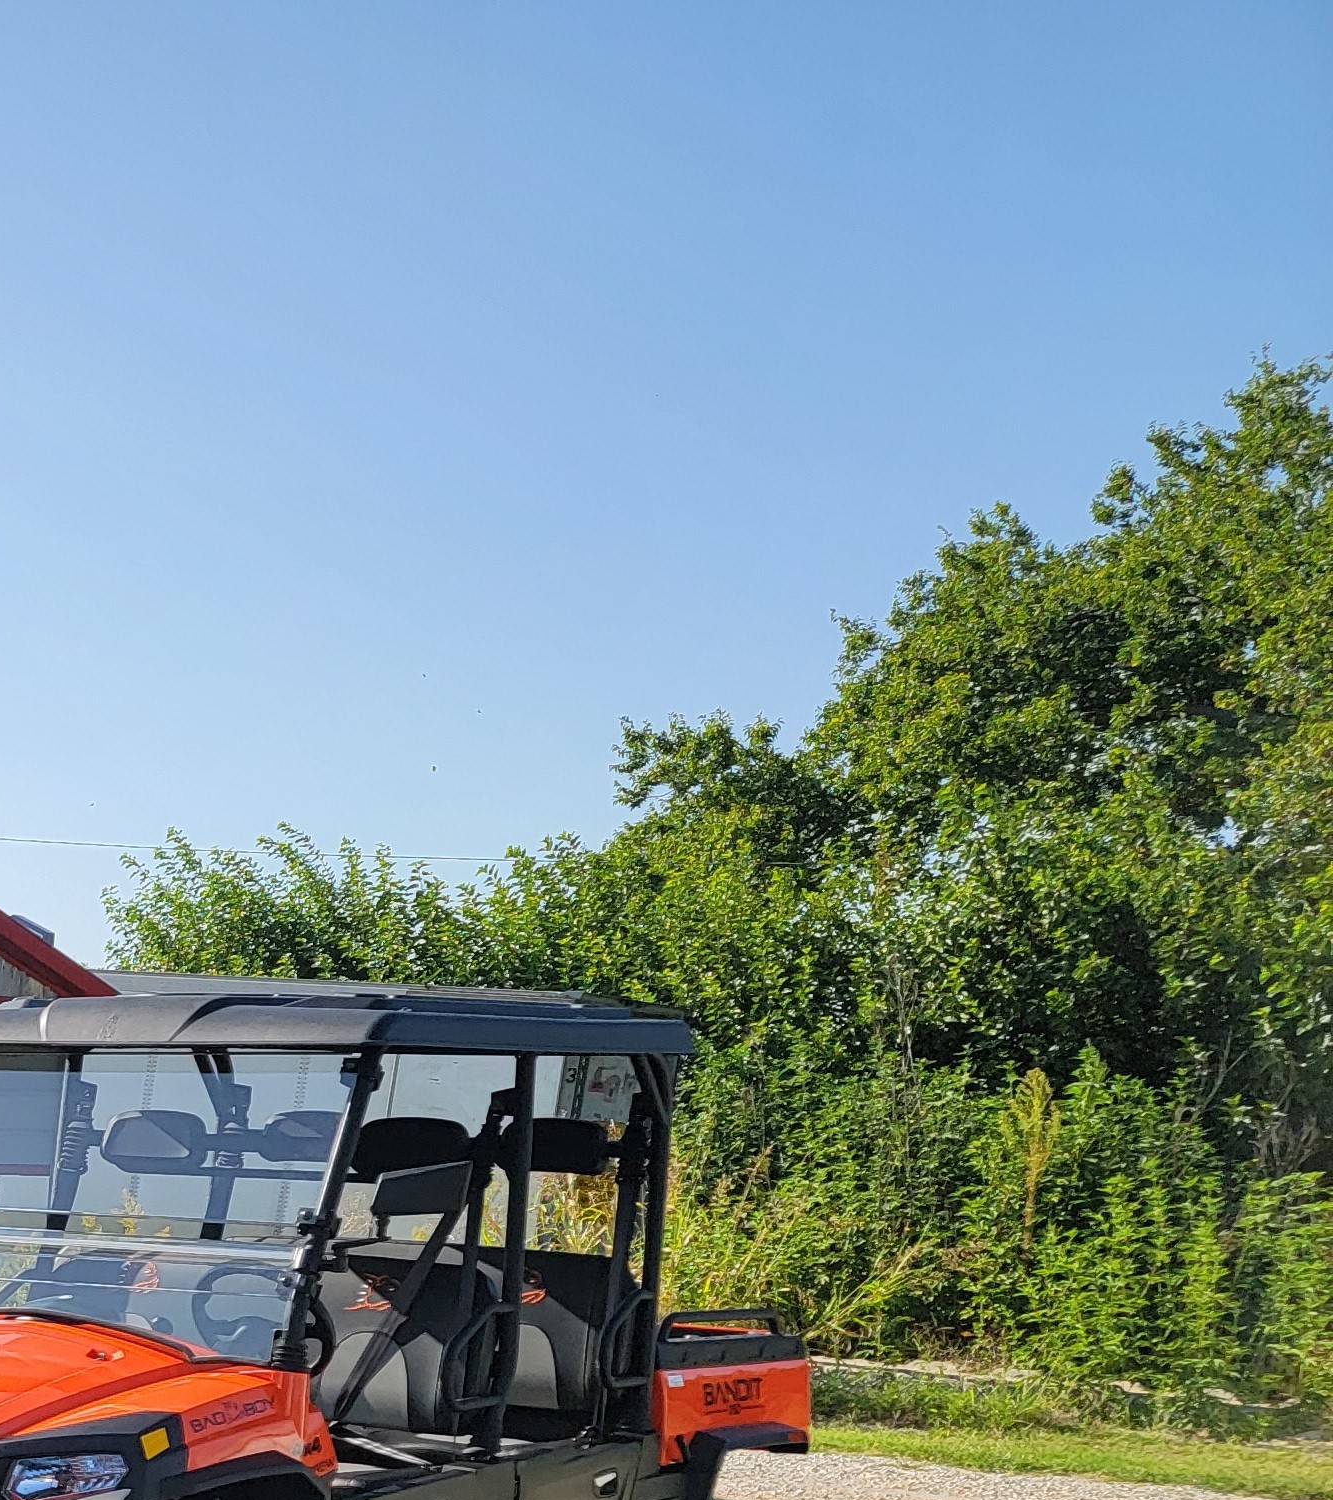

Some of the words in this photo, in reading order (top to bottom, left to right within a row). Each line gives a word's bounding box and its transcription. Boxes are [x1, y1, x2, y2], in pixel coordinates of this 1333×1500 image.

[566, 1067, 577, 1083] 3
[702, 1377, 763, 1406] BANDIT
[189, 1411, 226, 1433] BAD
